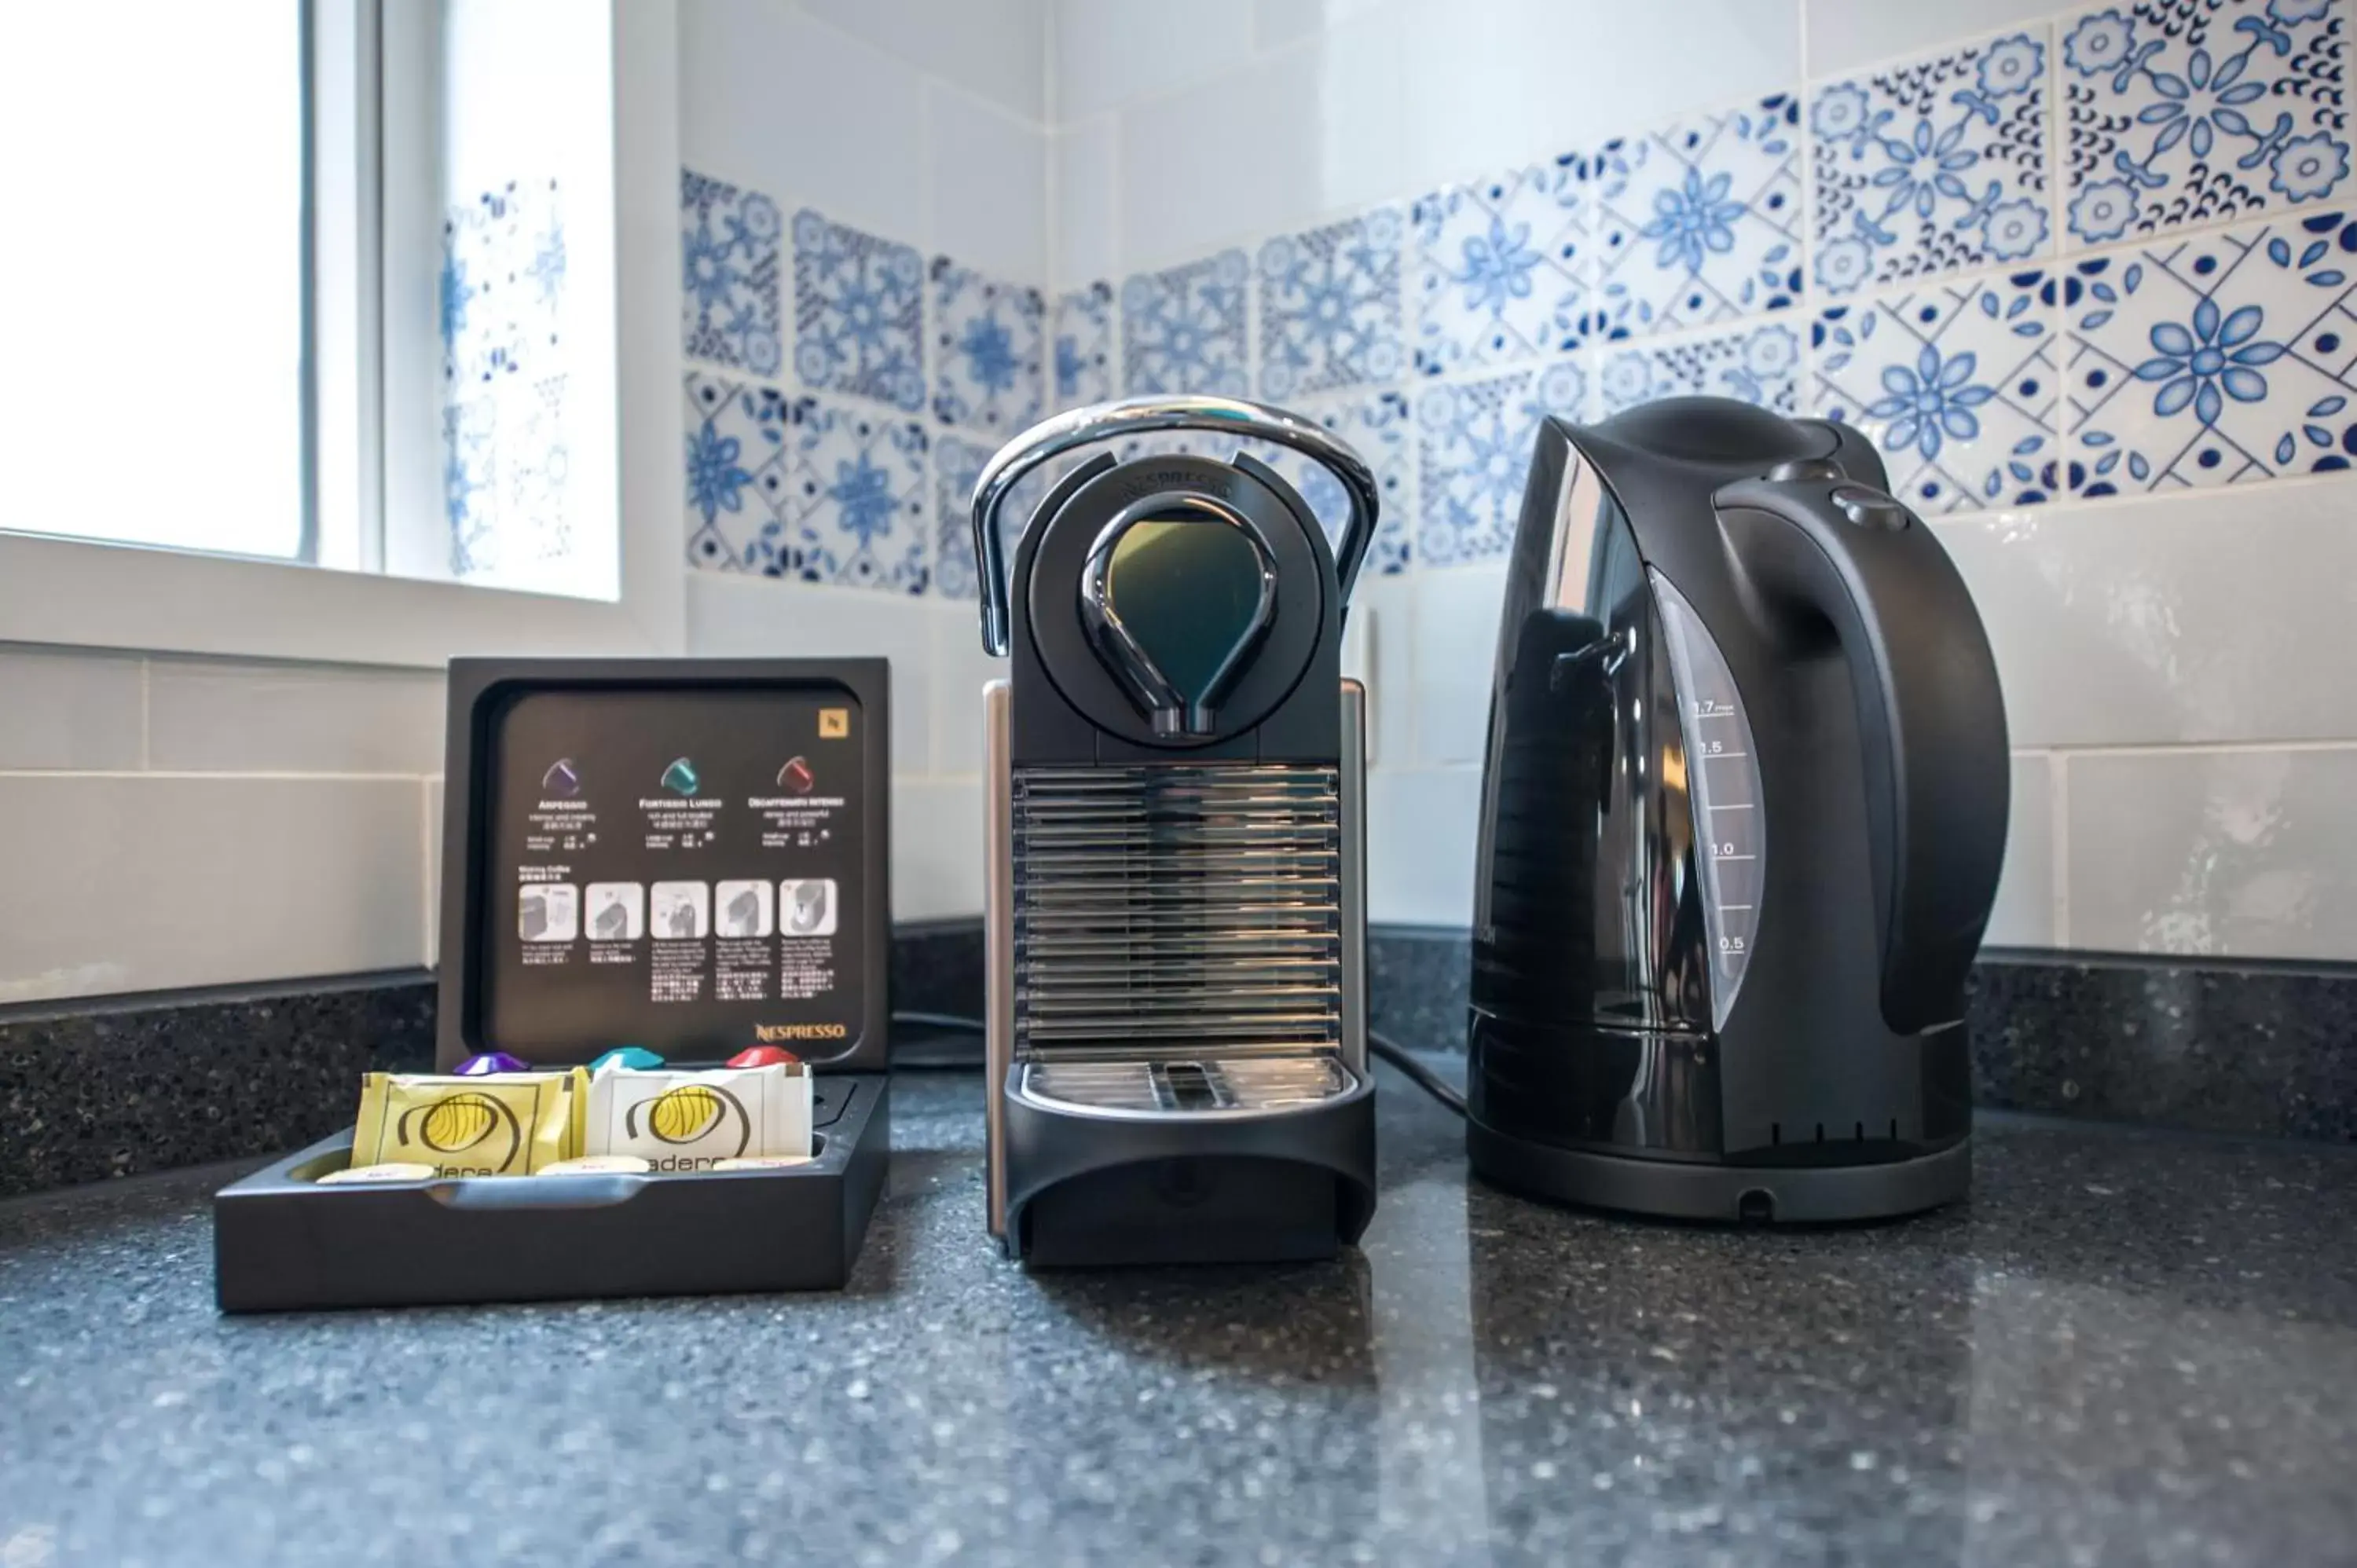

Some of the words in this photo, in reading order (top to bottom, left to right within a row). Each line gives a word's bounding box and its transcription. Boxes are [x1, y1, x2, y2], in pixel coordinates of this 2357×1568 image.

[1700, 742, 1722, 753] 1.5
[1711, 842, 1734, 855] 1.0
[1719, 936, 1744, 950] 0.5
[755, 1024, 847, 1041] NESPRESSO
